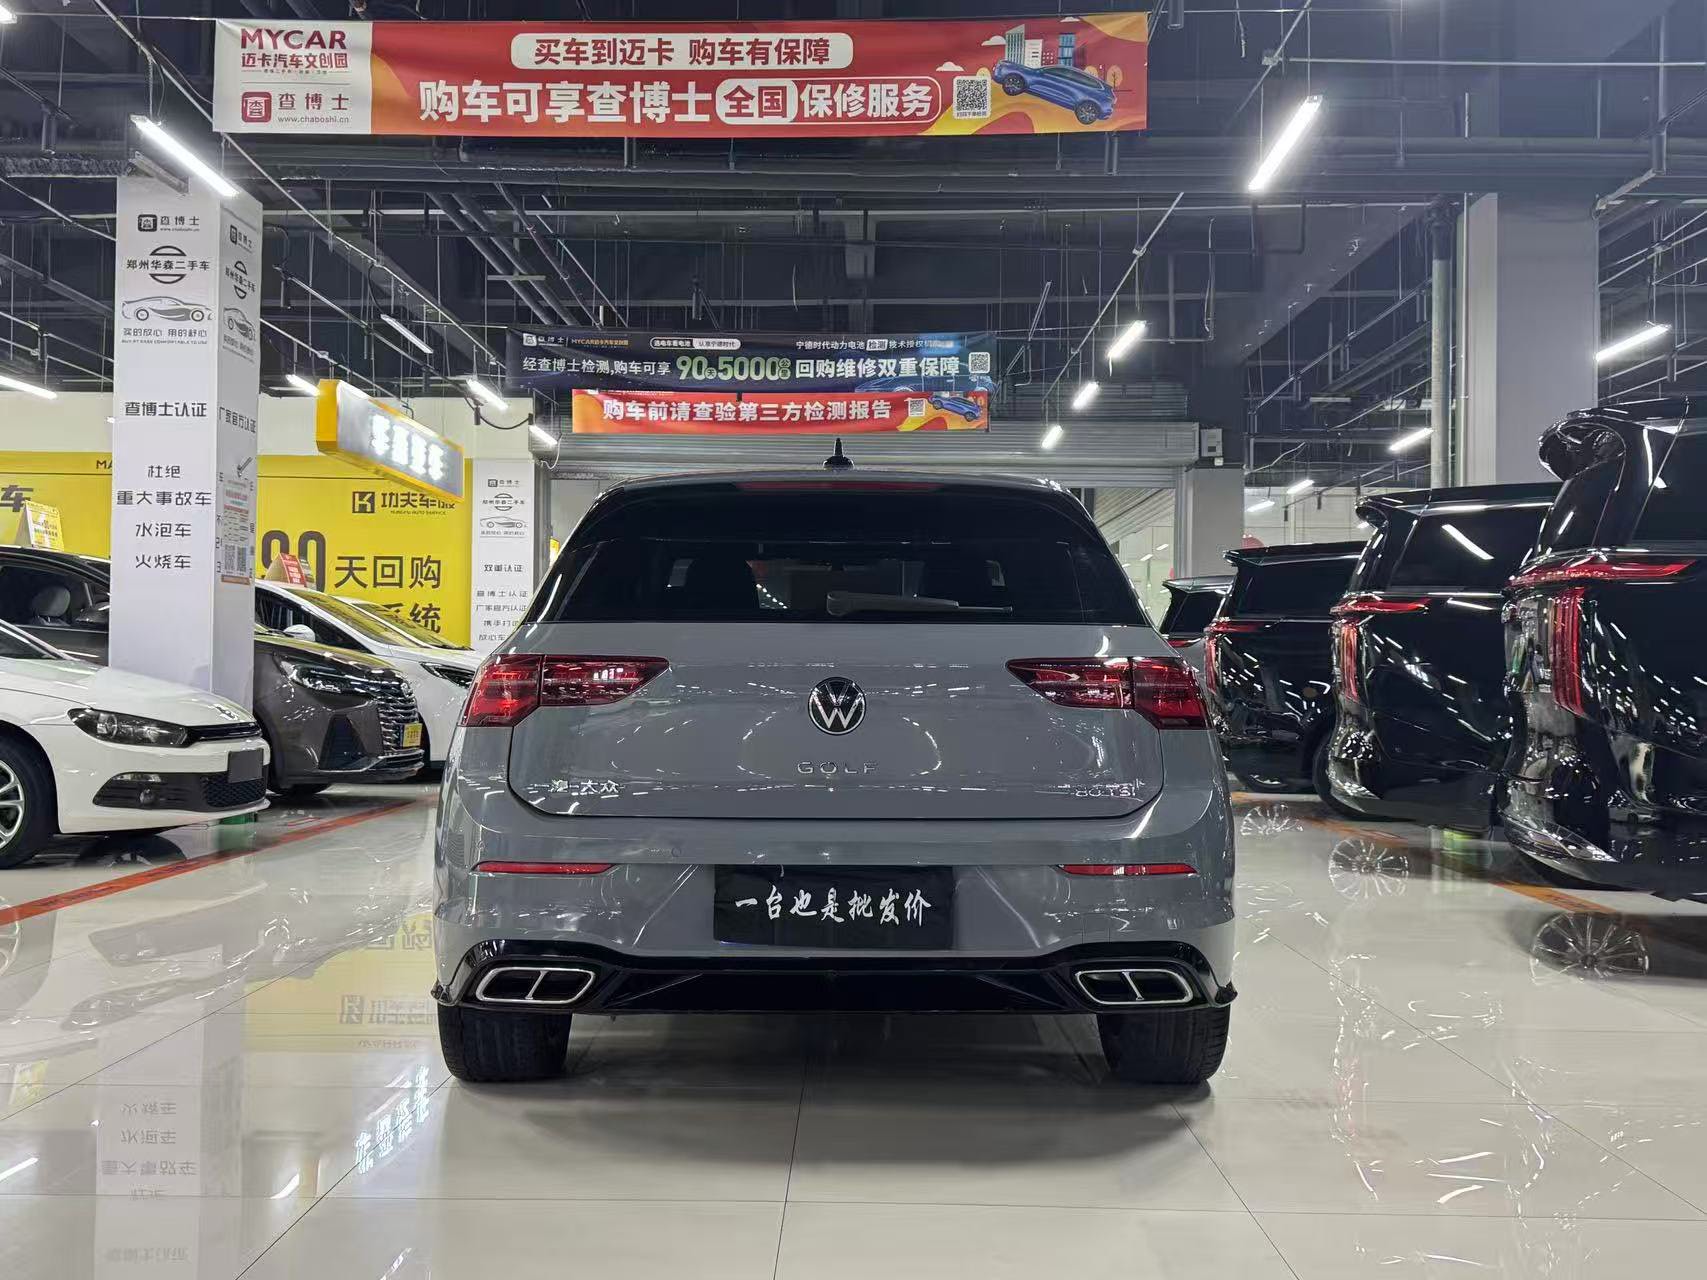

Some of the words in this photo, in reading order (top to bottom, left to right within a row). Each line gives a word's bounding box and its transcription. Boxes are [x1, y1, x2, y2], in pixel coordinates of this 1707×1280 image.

[241, 28, 347, 50] MYCAR
[535, 37, 675, 65] 买车到迈卡
[688, 37, 831, 66] 购车有保障
[241, 52, 349, 69] 迈卡汽车文创园
[278, 92, 350, 111] 查博士
[419, 79, 711, 124] 购车可享查博士
[722, 83, 785, 120] 全国
[799, 81, 933, 120] 保修服务
[126, 258, 211, 271] 郑州华森二手车
[522, 356, 672, 376] 经查博士检测,购车可享
[795, 356, 960, 379] 回购维修双重保障
[124, 401, 208, 418] 查博士认证
[603, 399, 893, 422] 购车前请查验第三方检测报告
[147, 464, 181, 479] 杜绝
[116, 490, 212, 506] 重大事故车
[135, 522, 192, 538] 水泡车
[135, 554, 192, 570] 火烧车
[797, 761, 879, 775] GOLF
[735, 887, 932, 926] 一台也是批发价
